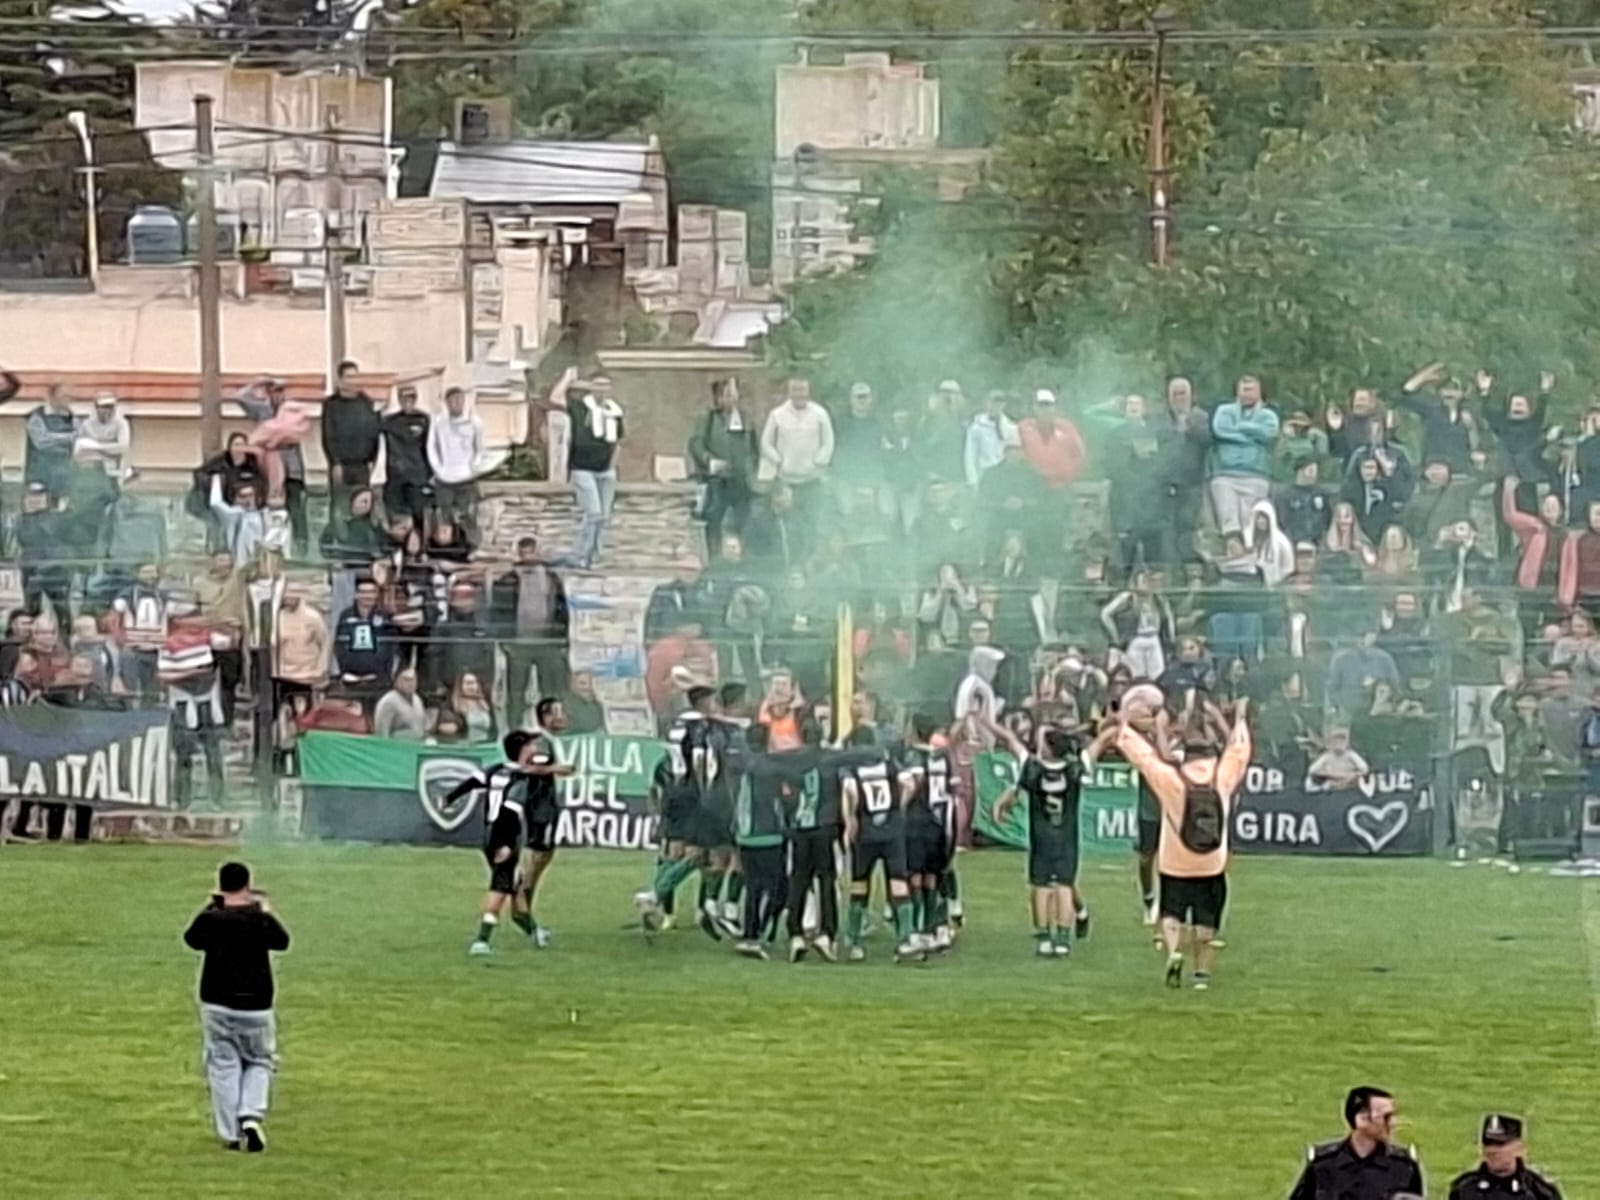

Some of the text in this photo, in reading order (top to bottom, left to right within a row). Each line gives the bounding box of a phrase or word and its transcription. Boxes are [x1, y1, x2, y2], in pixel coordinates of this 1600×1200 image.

[56, 725, 170, 807] ITALIA
[553, 737, 643, 773] VILLA
[565, 774, 627, 810] DEL
[1246, 766, 1284, 793] OR
[554, 809, 660, 850] ARQUE
[1235, 811, 1321, 844] GIRA
